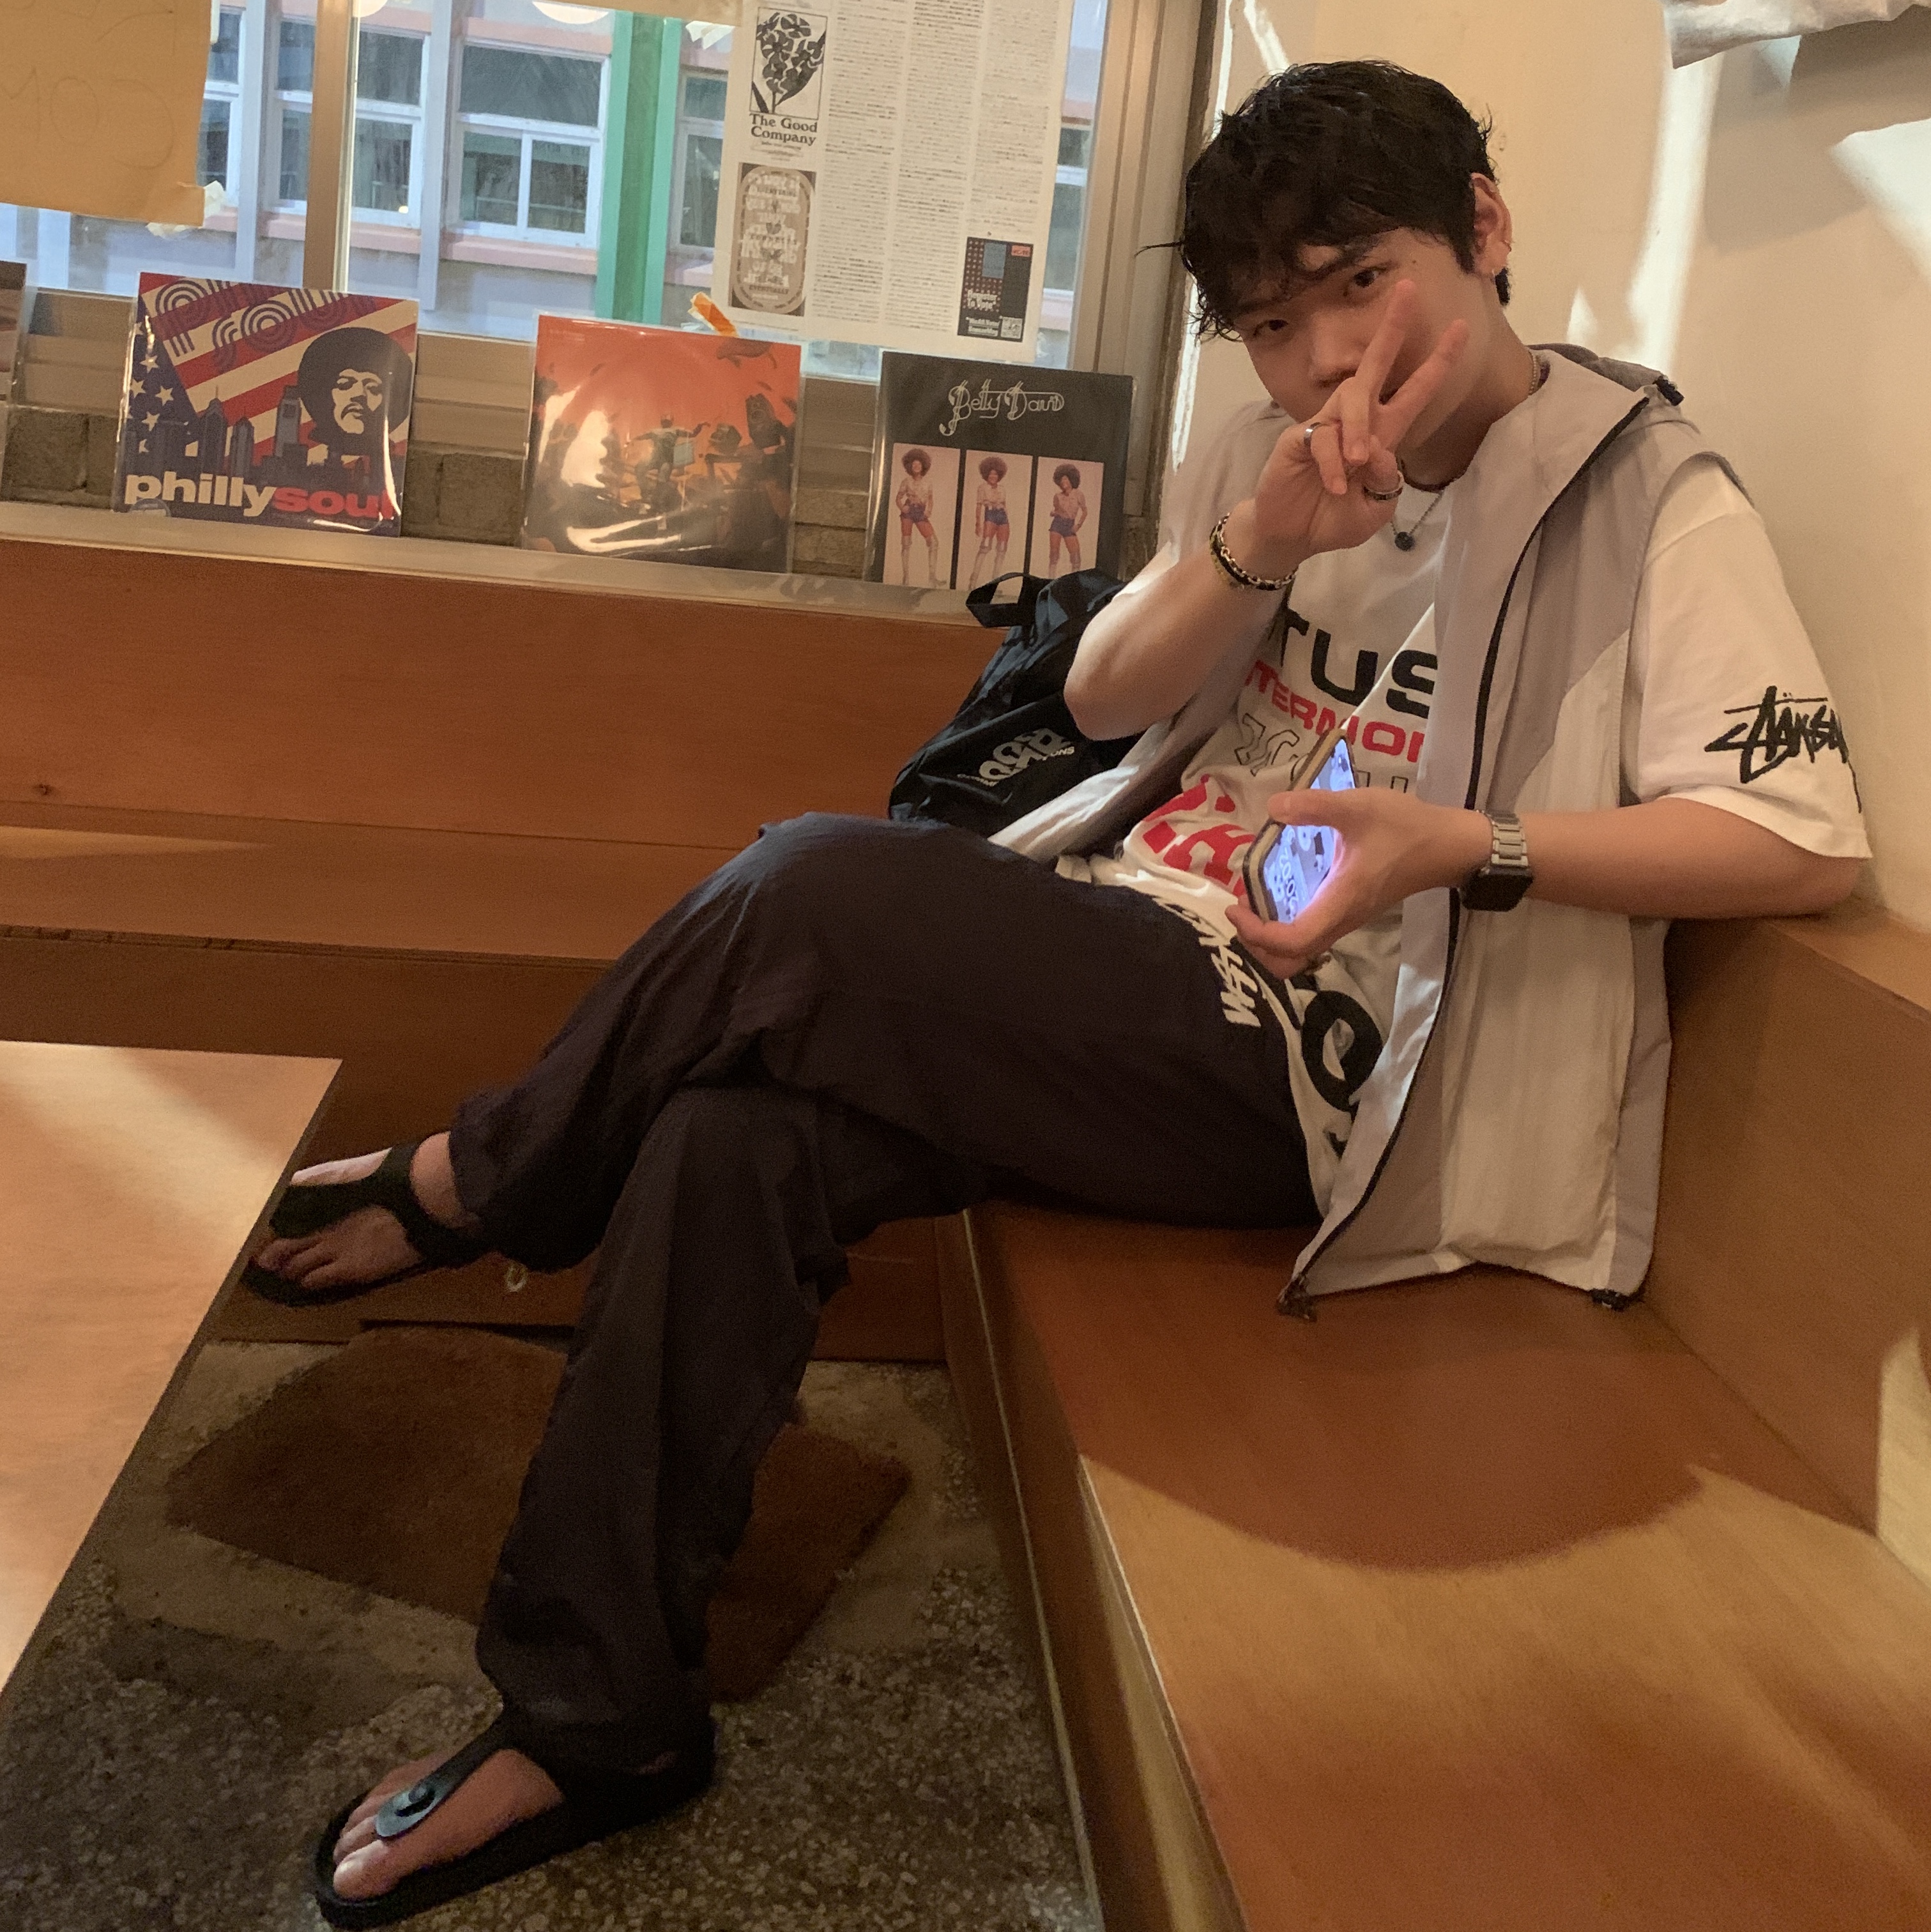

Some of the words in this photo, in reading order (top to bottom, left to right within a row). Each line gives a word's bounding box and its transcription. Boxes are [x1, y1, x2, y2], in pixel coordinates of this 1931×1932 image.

[749, 112, 777, 127] The
[781, 118, 818, 133] Good
[751, 125, 817, 146] Company
